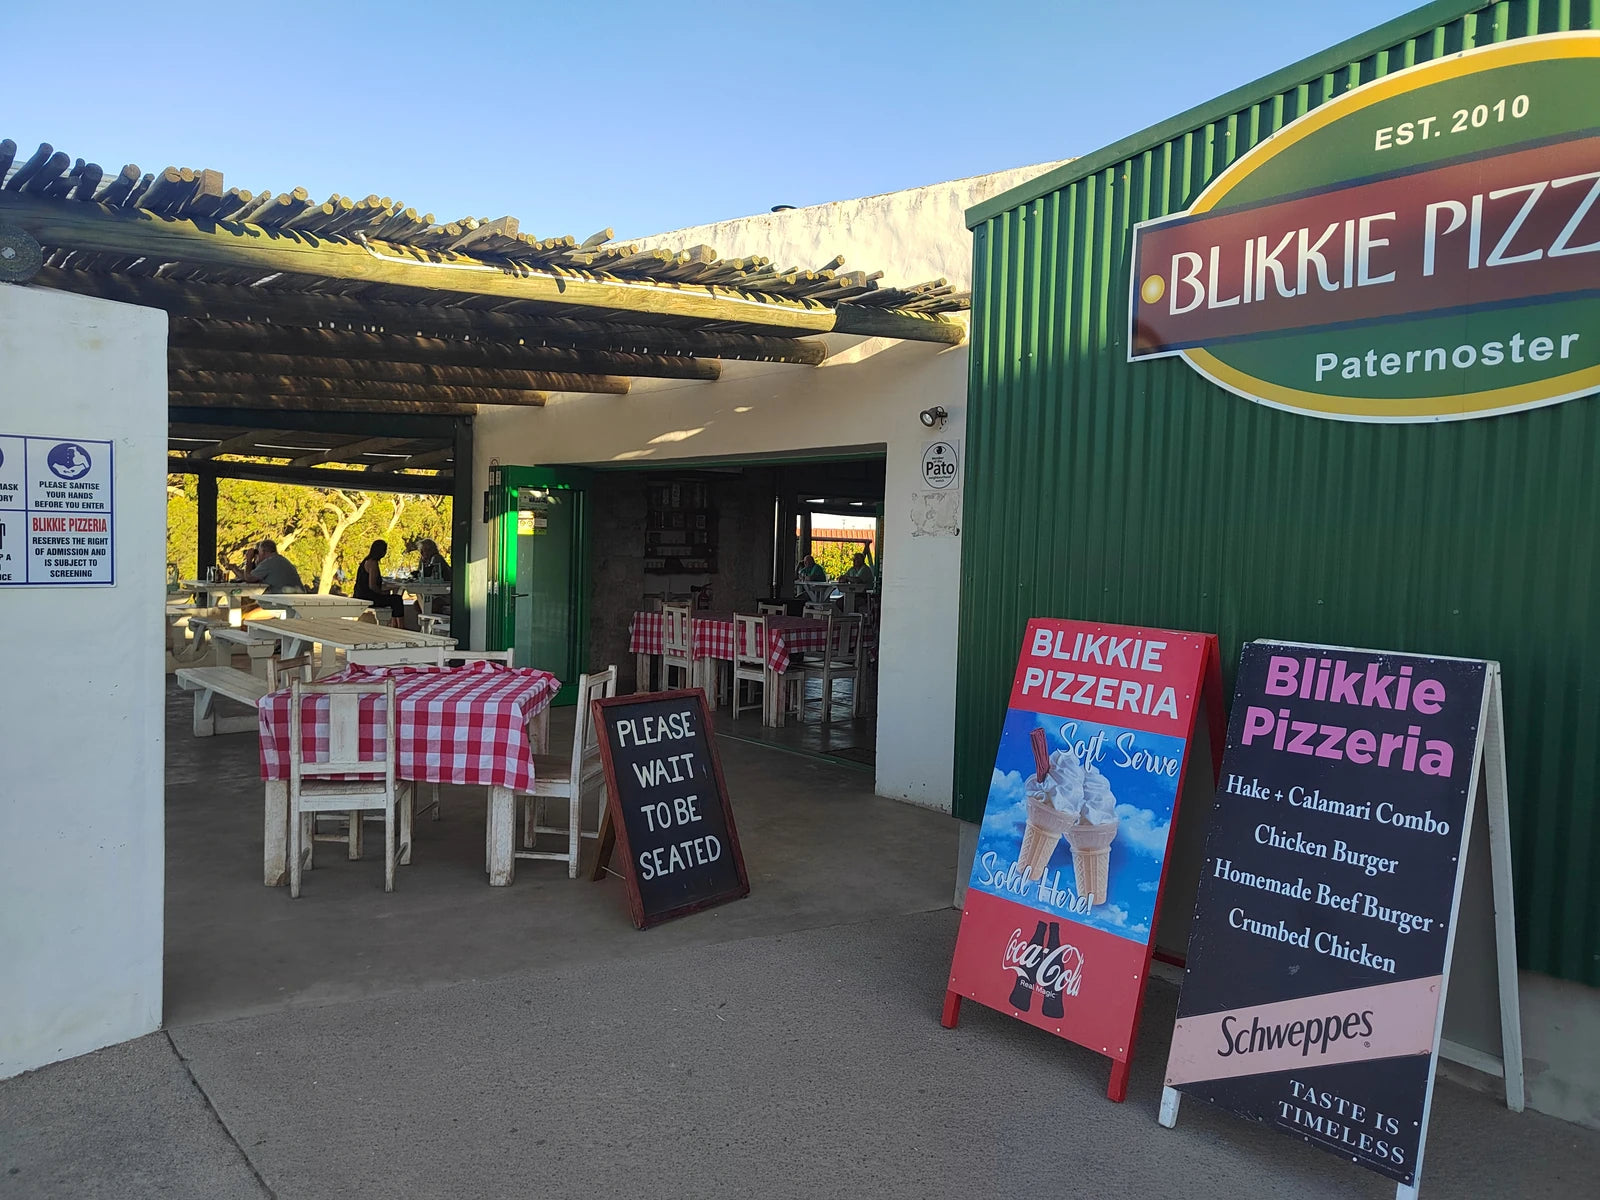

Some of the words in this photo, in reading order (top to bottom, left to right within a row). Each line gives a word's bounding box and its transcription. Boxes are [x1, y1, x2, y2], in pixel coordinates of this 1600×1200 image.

[1374, 116, 1441, 151] EST.
[1450, 94, 1530, 134] 2010
[1168, 211, 1396, 315] BLIKKIE
[1422, 171, 1600, 277] PIZZ
[1315, 331, 1580, 382] Paternoster
[39, 481, 67, 489] PLEASE
[69, 482, 100, 490] SANTISE
[926, 461, 955, 476] Pato
[68, 492, 93, 500] HANDS
[82, 502, 104, 510] ENTER
[32, 517, 66, 532] BLIKKIE
[69, 518, 107, 532] PIZZERIA
[32, 537, 70, 545] RESERVES
[72, 537, 86, 545] THE
[35, 548, 45, 556] OF
[47, 548, 89, 556] ADMISSION
[91, 548, 106, 556] AND
[44, 559, 52, 567] IS
[54, 559, 87, 567] SUBJECT
[89, 559, 98, 567] TO
[50, 569, 93, 578] SCREENING
[0, 573, 12, 581] CE
[1030, 628, 1168, 673] BLIKKIE
[1021, 667, 1179, 720] PIZZERIA
[1264, 655, 1447, 715] Blikkie
[616, 711, 696, 748] PLEASE
[1056, 721, 1109, 772] Soft
[1113, 732, 1179, 777] Serve
[1241, 705, 1455, 778] Pizzeria
[632, 753, 694, 789] WAIT
[640, 801, 672, 832] TO
[673, 795, 702, 827] BE
[1226, 773, 1271, 801] Hake
[1288, 786, 1371, 821] Calamari
[1375, 802, 1450, 836] Combo
[639, 835, 721, 881] SEATED
[1254, 823, 1327, 858] Chicken
[1332, 839, 1399, 877] Burger
[978, 851, 1032, 896] Sold
[1037, 866, 1095, 916] Here!
[1213, 857, 1312, 902] Homemade
[1314, 883, 1363, 914] Beef
[1362, 894, 1434, 935] Burger
[1228, 907, 1310, 949] Crumbed
[1314, 931, 1397, 975] Chicken
[1020, 979, 1035, 991] Real
[1035, 985, 1057, 999] Magic
[1217, 1010, 1374, 1057] Schweppes
[1289, 1079, 1366, 1123] TASTE
[1374, 1112, 1400, 1136] IS
[1278, 1101, 1406, 1166] TIMELESS
